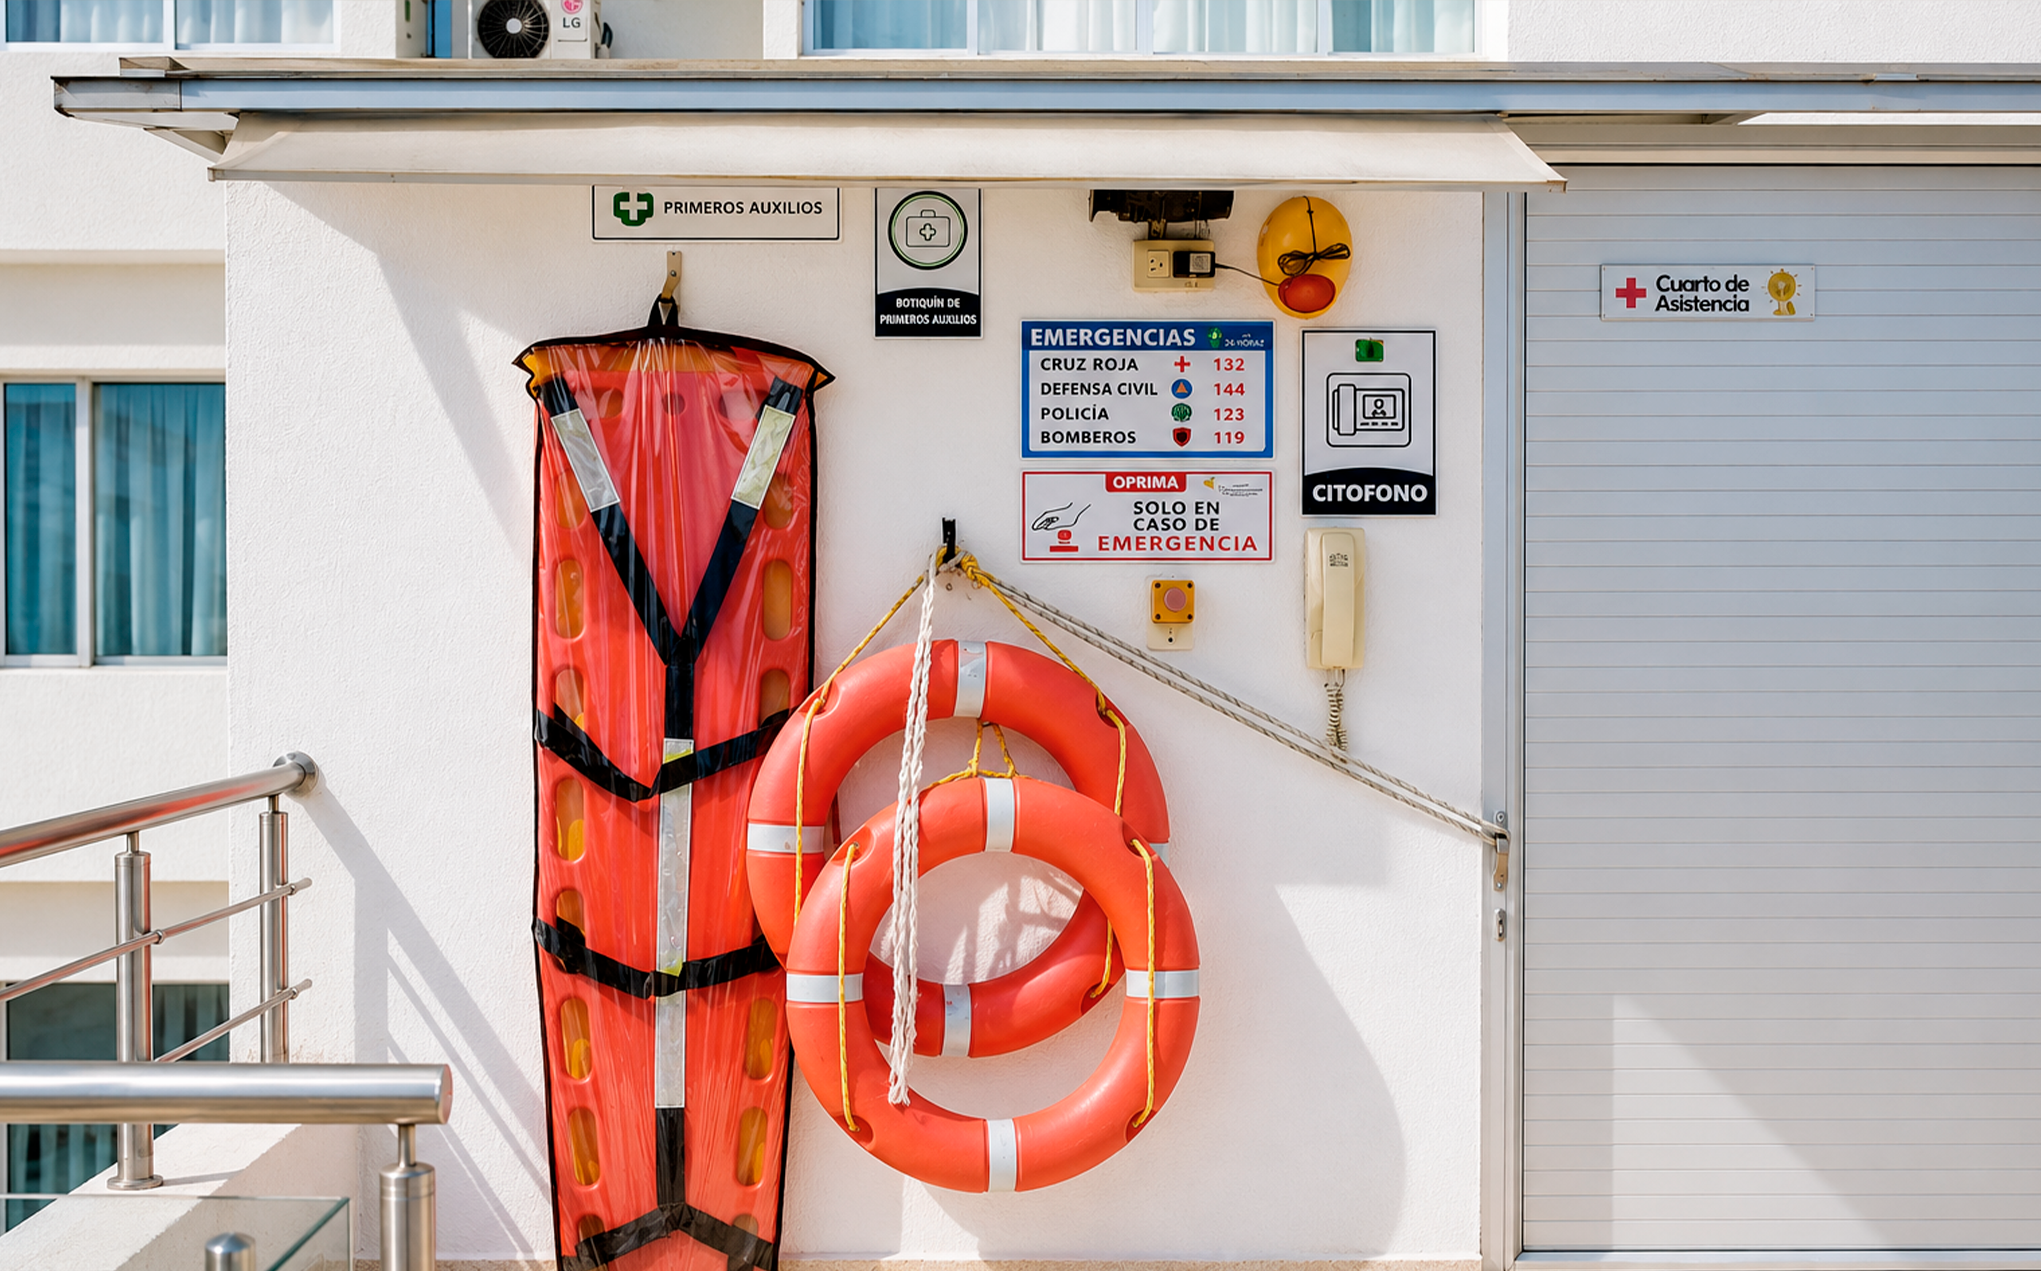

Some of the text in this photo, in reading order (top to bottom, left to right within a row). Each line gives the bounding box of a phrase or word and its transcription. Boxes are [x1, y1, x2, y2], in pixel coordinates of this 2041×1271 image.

[562, 17, 581, 28] LG
[663, 201, 823, 215] PRIMEROS AUXILIOS
[1655, 274, 1750, 292] Cuarto de
[896, 295, 961, 309] BOTIQUÍN DE
[1655, 294, 1750, 312] Asistencia
[1029, 328, 1196, 347] EMERGENCIAS
[1040, 357, 1245, 372] CRUZ ROJA 132
[1040, 382, 1246, 396] DEFENSA CIVIL 144
[1041, 403, 1245, 422] POLICÍA 123
[1040, 430, 1245, 444] BOMBEROS 119
[1112, 475, 1179, 489] OPRIMA
[1312, 484, 1428, 502] CITOFONO
[1133, 500, 1220, 516] SOLO EN
[1133, 517, 1220, 532] CASO DE
[1098, 535, 1258, 552] EMERGENCIA
